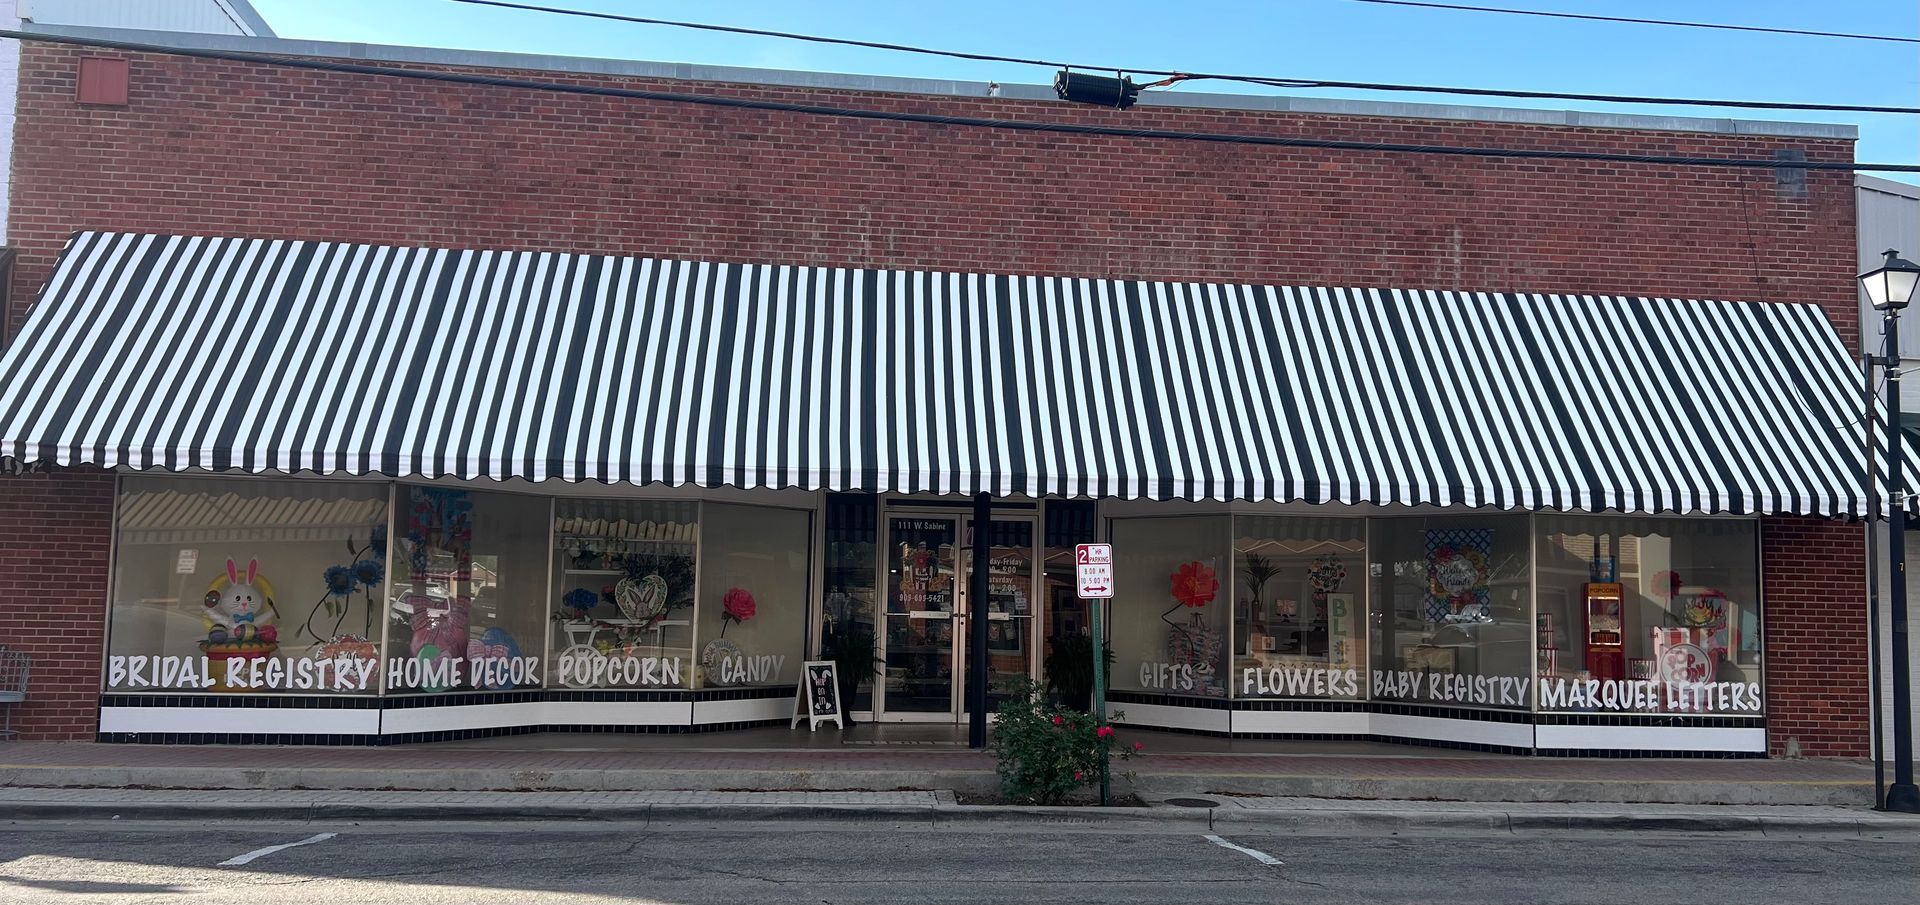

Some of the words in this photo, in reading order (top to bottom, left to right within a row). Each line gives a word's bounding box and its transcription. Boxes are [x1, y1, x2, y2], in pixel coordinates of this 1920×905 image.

[898, 521, 911, 529] 111
[924, 522, 946, 531] Sabine
[1079, 550, 1087, 563] 2
[1084, 567, 1096, 575] 8:00
[988, 576, 1014, 584] aturday
[108, 655, 217, 688] BRIDAL
[226, 656, 377, 689] REGISTRY
[387, 656, 463, 689] HOME
[470, 657, 541, 688] DECOR
[558, 656, 681, 686] POPCORN
[721, 655, 785, 684] CANDY
[1139, 662, 1195, 691] GIFTS
[1243, 667, 1359, 697] FLOWERS
[1373, 670, 1423, 699] BABY
[1429, 673, 1529, 705] REGISTRY
[1540, 678, 1659, 710] MARQUEE
[1666, 681, 1761, 711] LETTERS
